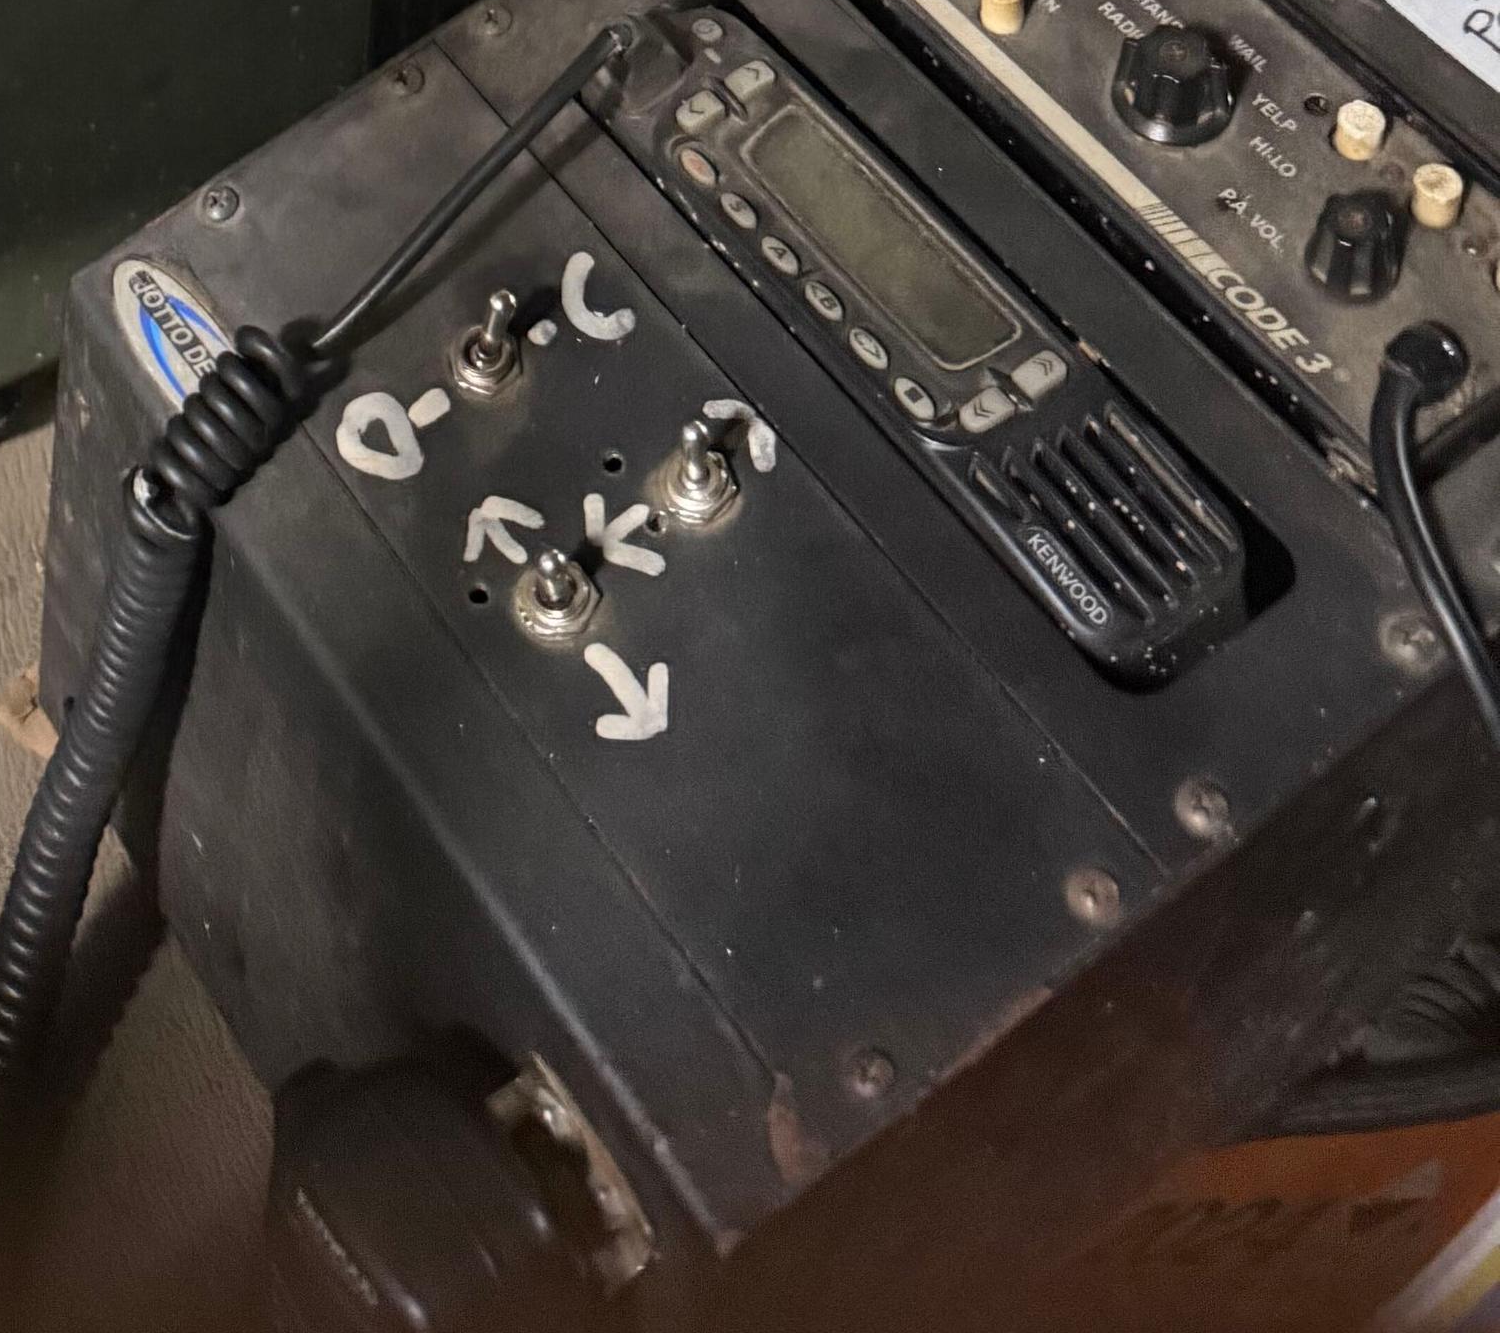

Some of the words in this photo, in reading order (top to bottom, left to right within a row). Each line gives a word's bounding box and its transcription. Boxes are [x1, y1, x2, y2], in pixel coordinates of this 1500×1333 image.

[1230, 33, 1269, 73] WAIL
[1251, 91, 1298, 133] YELP
[1207, 267, 1310, 351] CODE
[1295, 352, 1333, 375] 3
[1027, 533, 1107, 625] KENWOOD
